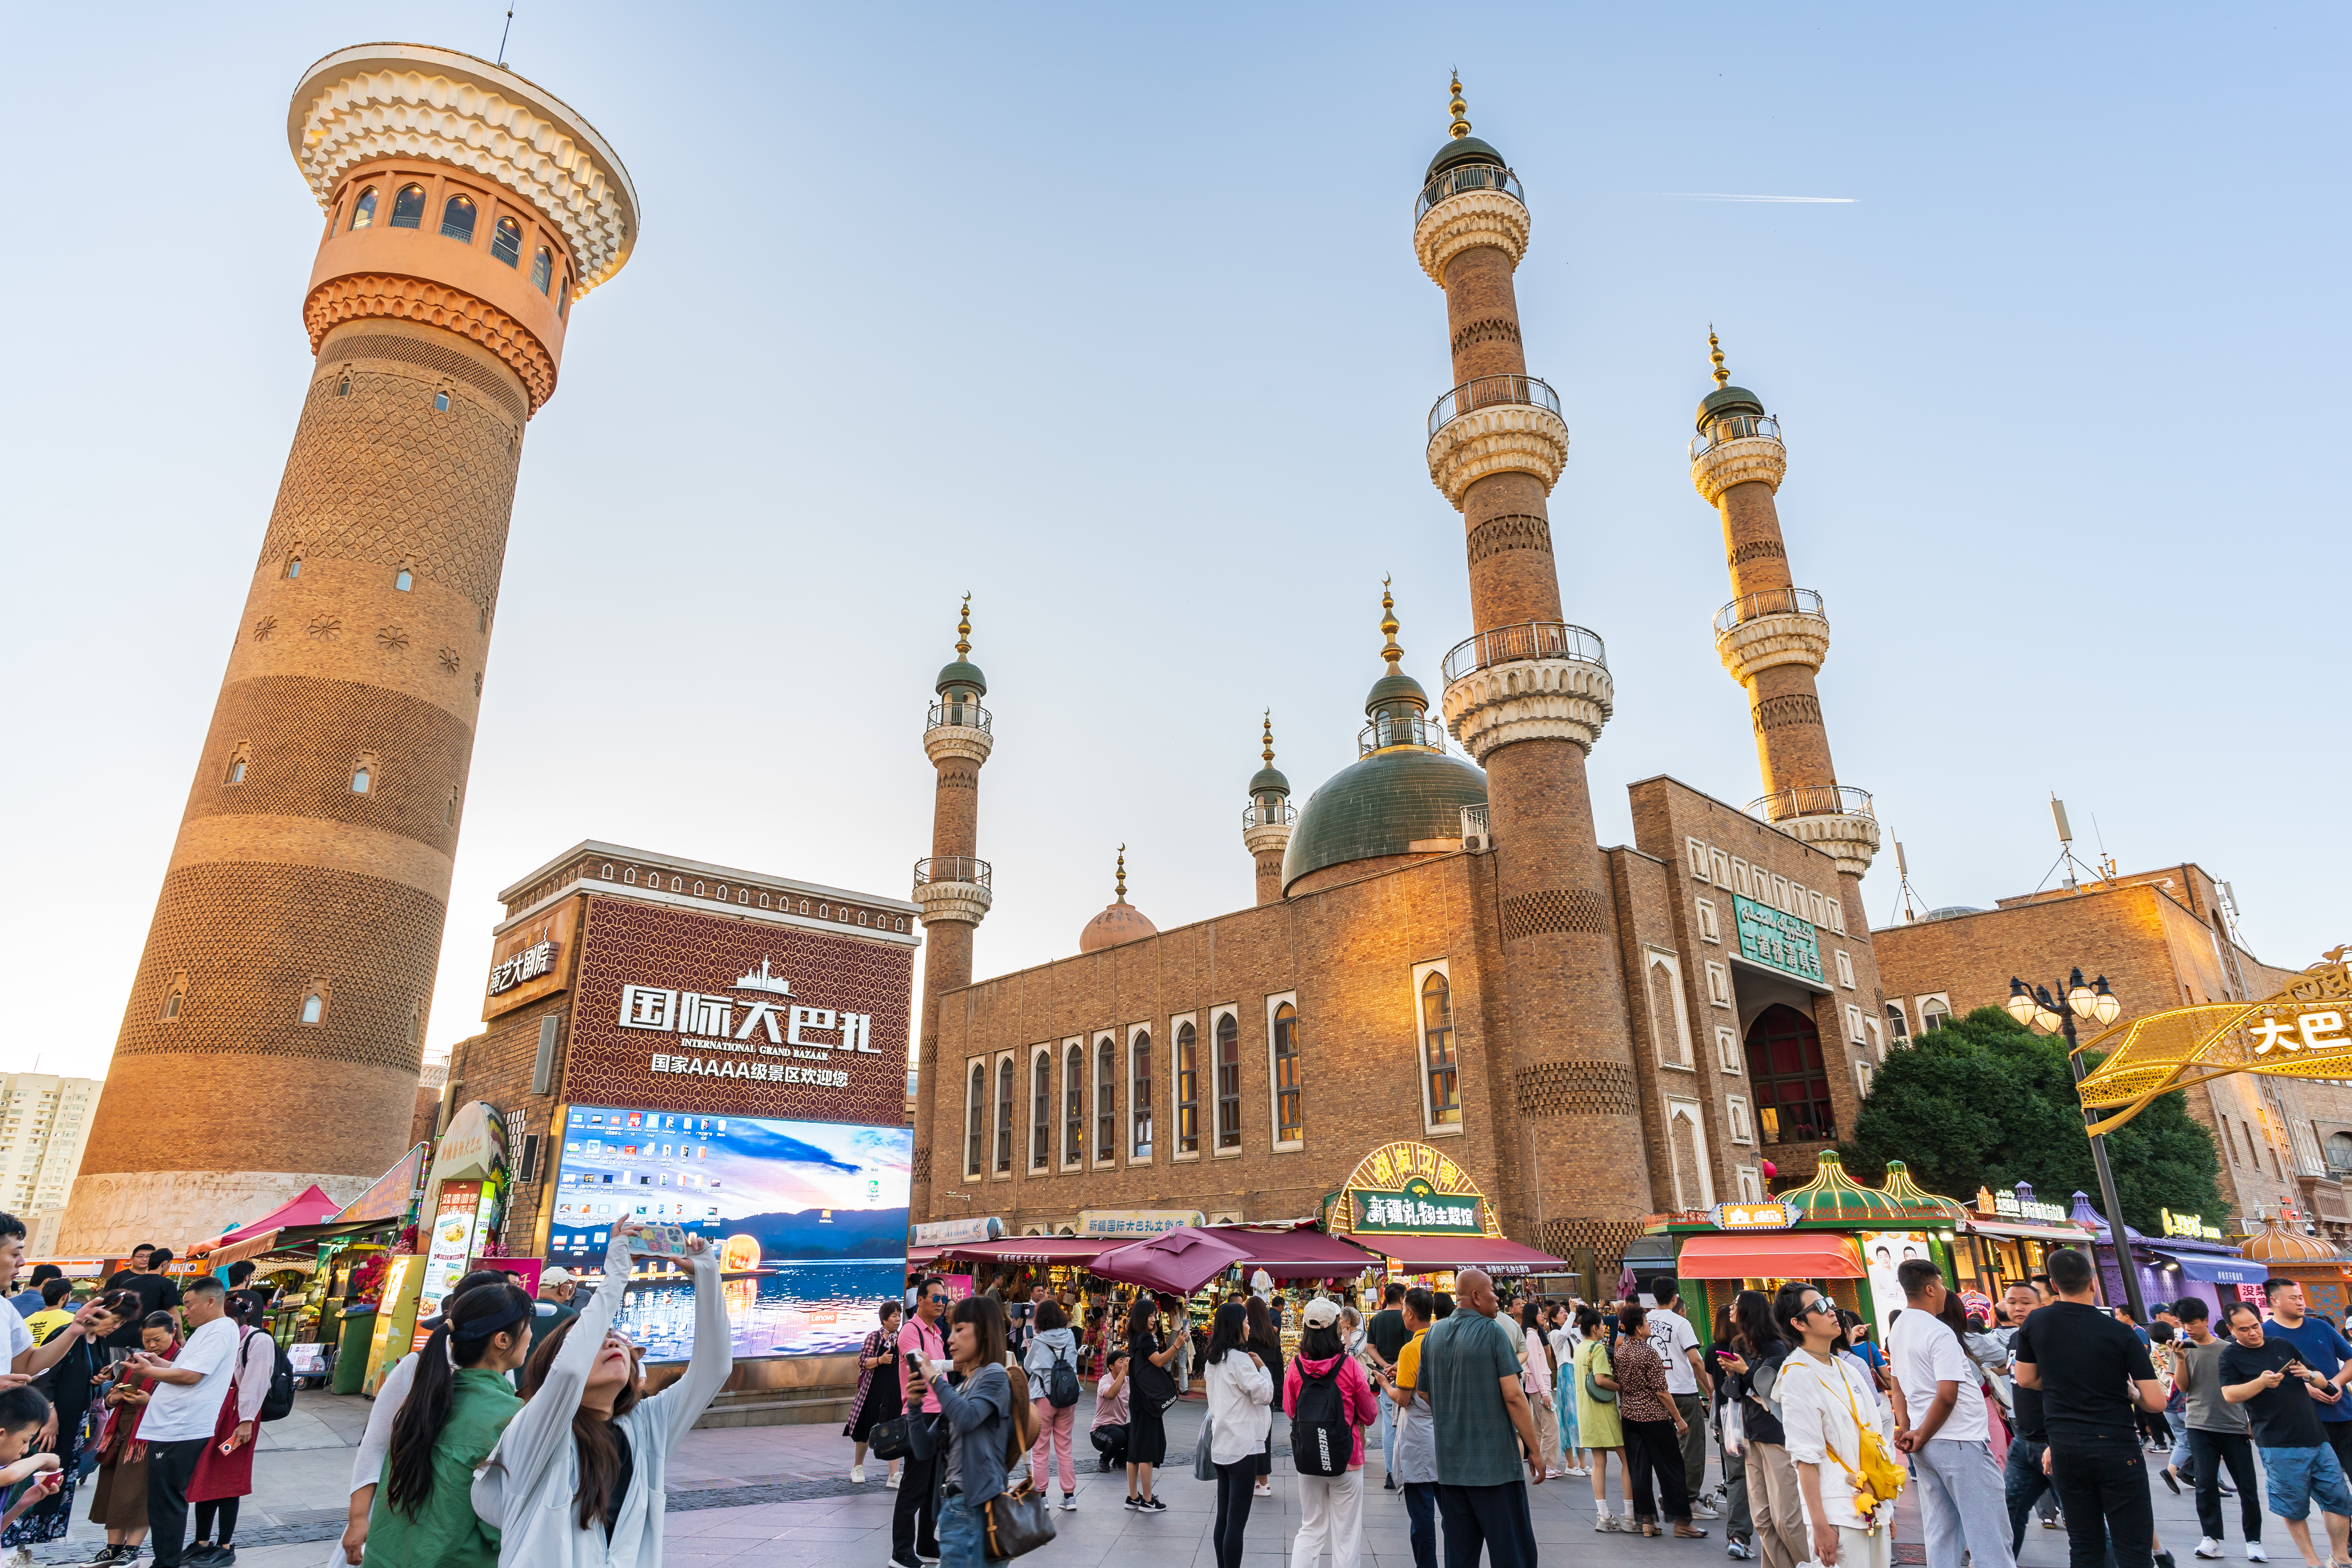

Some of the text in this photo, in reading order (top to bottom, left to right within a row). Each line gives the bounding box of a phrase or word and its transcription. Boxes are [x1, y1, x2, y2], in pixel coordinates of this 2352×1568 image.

[488, 941, 550, 996] 演艺大剧院
[1744, 932, 1821, 976] 二道桥清真寺
[619, 984, 881, 1054] 国际大巴扎
[2249, 1011, 2352, 1056] 大巴
[681, 1038, 829, 1061] INTERNATIONAL GRAND BAZAAR
[651, 1053, 849, 1088] 国家AAAA级景区欢迎您
[1373, 1148, 1457, 1188] 战友之家
[441, 1193, 478, 1204] 重磅推荐
[1366, 1195, 1474, 1227] 新疆礼物主题馆
[434, 1242, 468, 1254] OPENING
[997, 1254, 1049, 1263] 新疆特色工艺品店
[811, 1314, 835, 1322] Lenovo
[1161, 1394, 1177, 1410] adidas
[1317, 1427, 1332, 1472] SKECHERS
